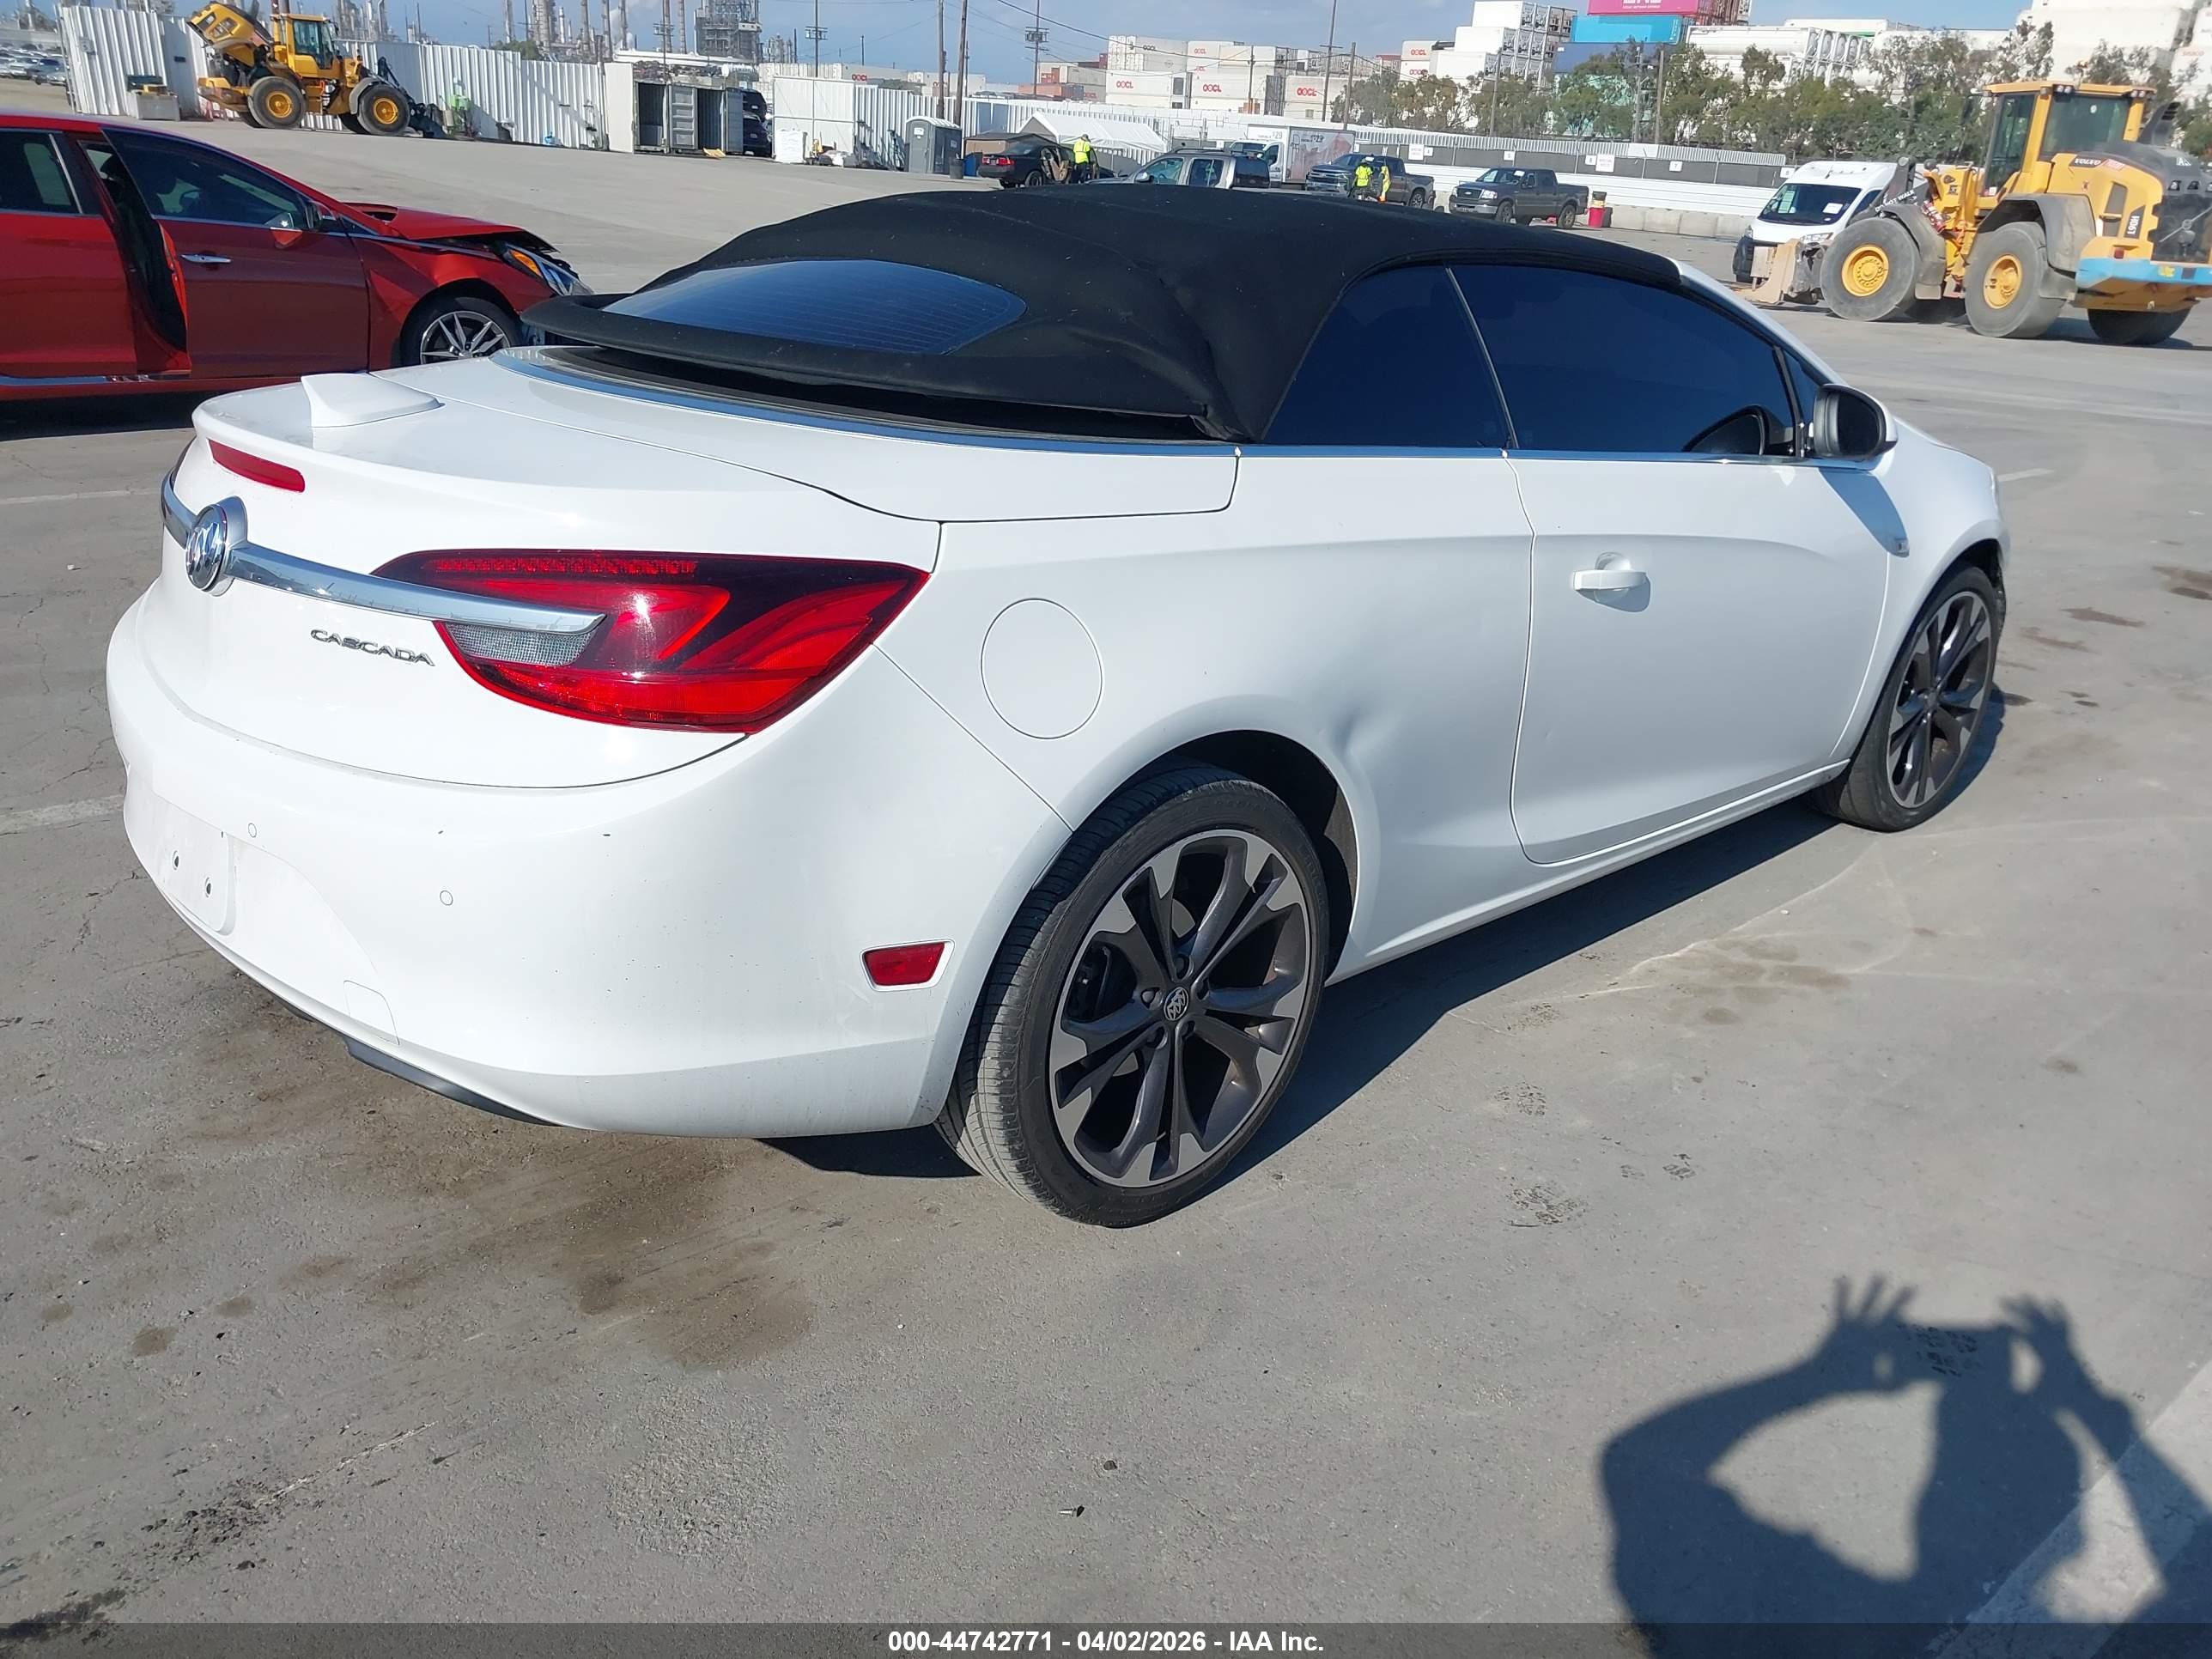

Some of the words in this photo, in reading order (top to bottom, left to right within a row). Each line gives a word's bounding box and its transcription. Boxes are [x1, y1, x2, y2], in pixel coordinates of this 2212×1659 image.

[1297, 88, 1316, 96] OOCL
[1897, 189, 1916, 201] WALK
[311, 629, 435, 666] CASCADA
